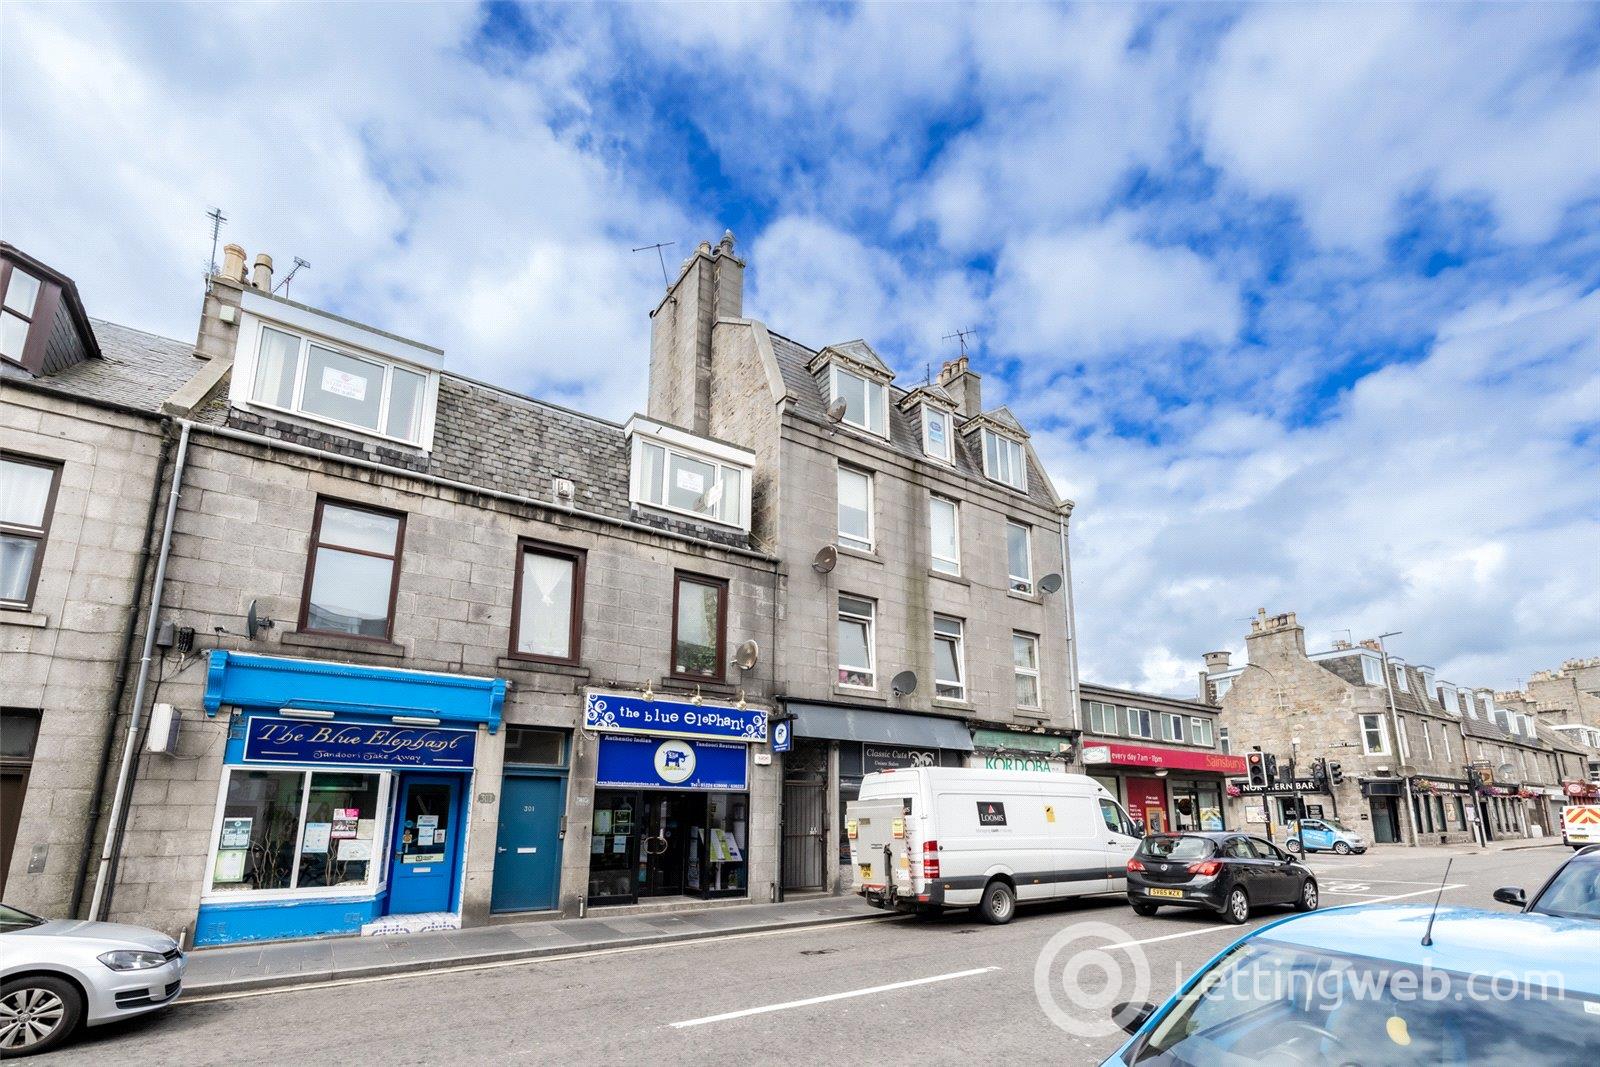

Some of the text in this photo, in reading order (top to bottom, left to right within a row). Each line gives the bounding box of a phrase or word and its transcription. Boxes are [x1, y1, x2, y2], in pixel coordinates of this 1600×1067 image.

[620, 706, 640, 718] the
[644, 708, 679, 723] blue
[257, 723, 469, 753] The Blue Elephant
[604, 735, 633, 743] Authentic
[363, 752, 389, 761] Take
[866, 749, 907, 759] Classic Cuts
[1111, 752, 1126, 761] every
[1127, 753, 1137, 761] day
[1152, 755, 1163, 764] 11pm
[985, 756, 1051, 773] KORDOBA
[1206, 755, 1246, 770] Sainsbury's
[1296, 782, 1315, 790] BAR
